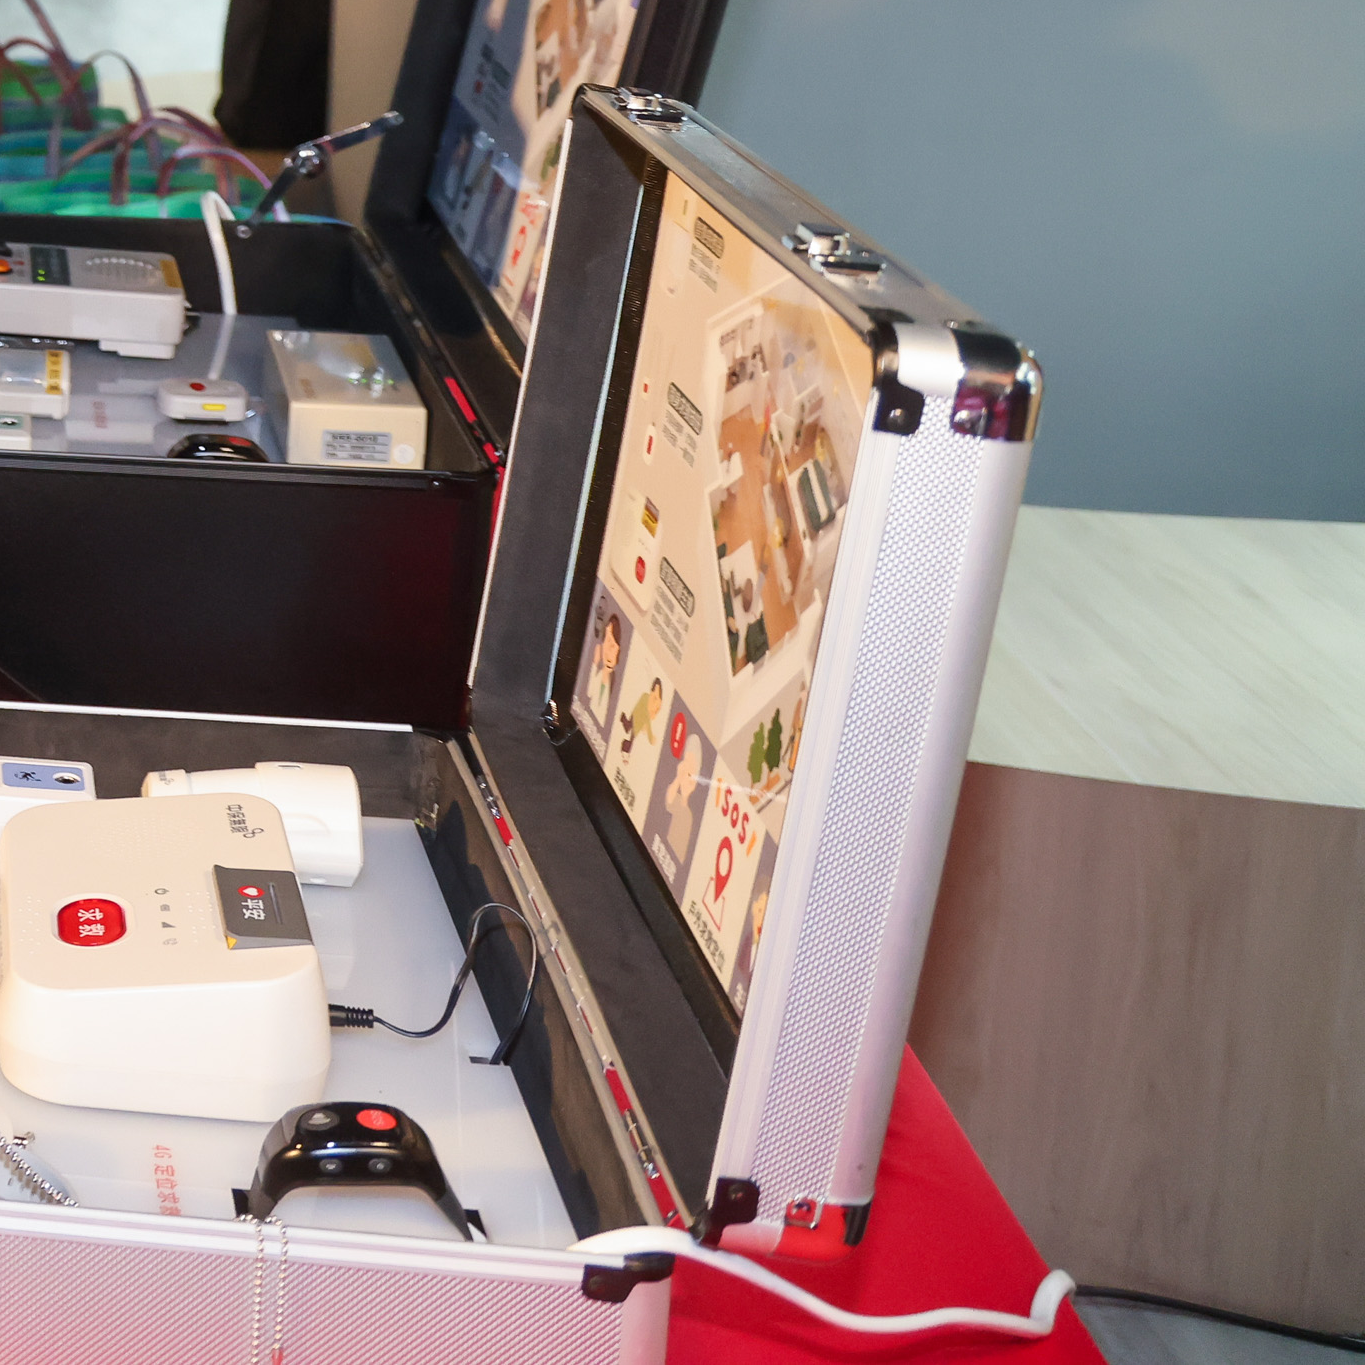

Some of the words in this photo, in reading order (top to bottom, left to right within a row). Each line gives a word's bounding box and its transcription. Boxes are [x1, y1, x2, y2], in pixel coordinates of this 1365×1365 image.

[721, 785, 750, 845] SOS
[77, 907, 106, 938] 求救
[241, 898, 266, 921] 平安
[152, 1144, 173, 1159] 4G
